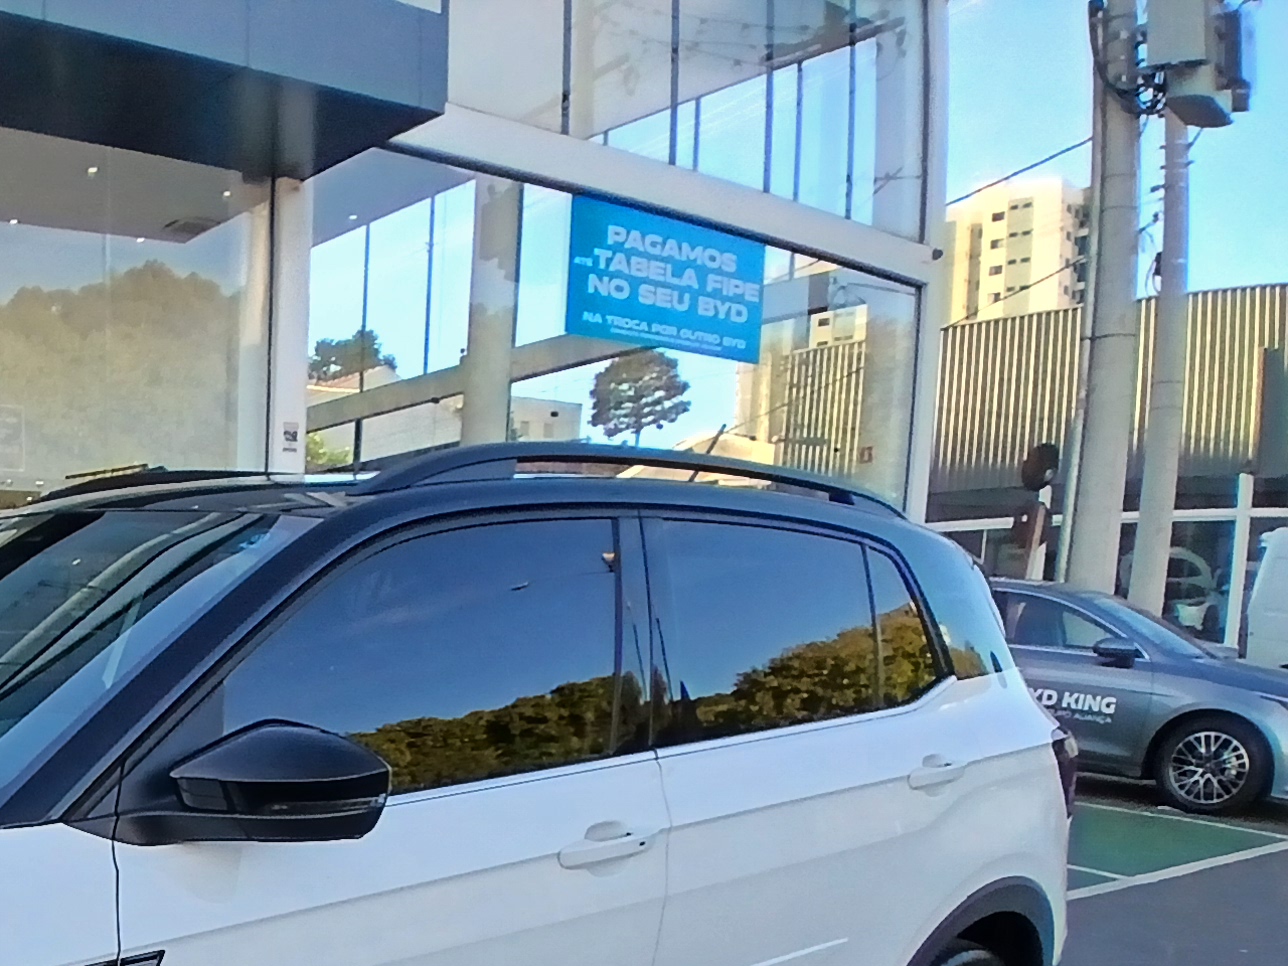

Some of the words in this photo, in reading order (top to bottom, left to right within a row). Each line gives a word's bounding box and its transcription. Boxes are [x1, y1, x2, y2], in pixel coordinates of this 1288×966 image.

[607, 225, 737, 273] PAGAMOS
[588, 274, 631, 300] NO
[638, 283, 690, 312] SEU
[698, 295, 748, 324] BYD
[594, 247, 699, 290] TABELA
[706, 272, 761, 303] FIPE
[582, 311, 603, 324] NA
[606, 315, 649, 332] TROCA
[651, 322, 678, 336] POR
[679, 328, 721, 345] OUTRO
[722, 336, 747, 349] BYD
[1028, 688, 1058, 706] YD
[1061, 691, 1117, 714] KING
